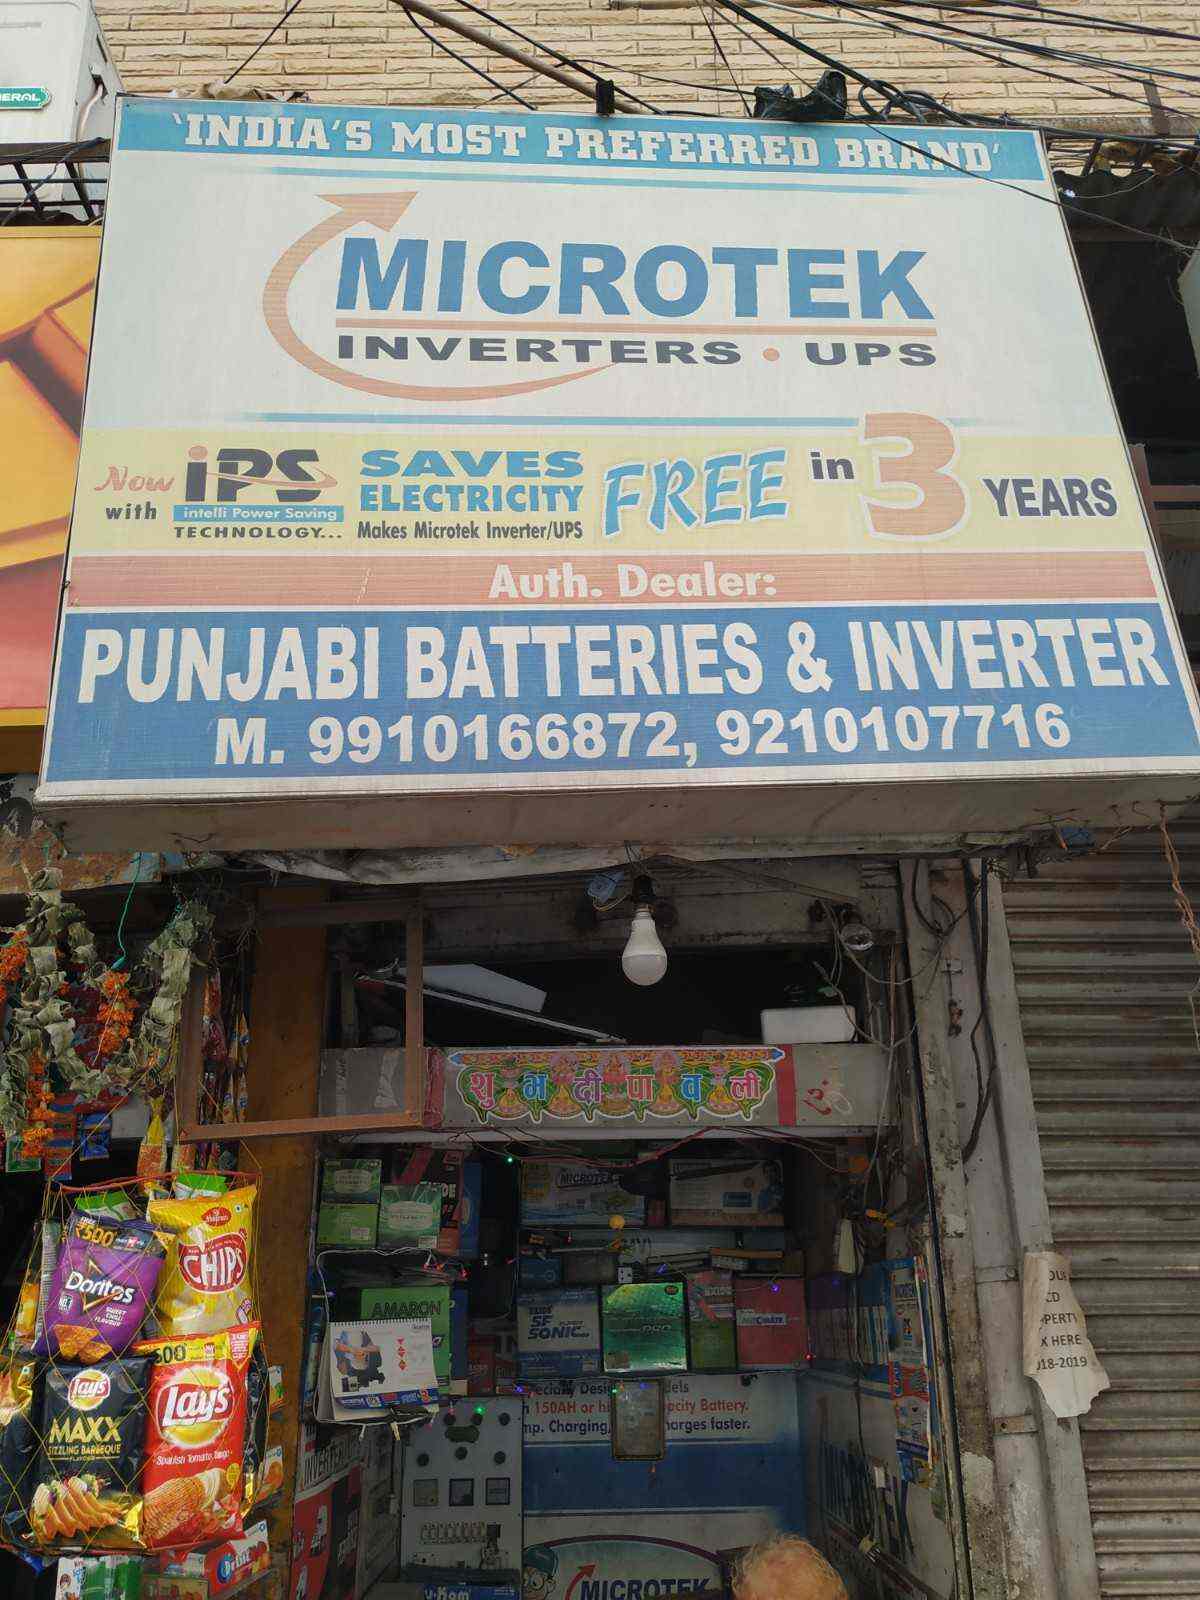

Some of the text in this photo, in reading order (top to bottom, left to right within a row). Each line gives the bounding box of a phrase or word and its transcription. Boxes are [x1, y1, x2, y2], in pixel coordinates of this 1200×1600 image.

[391, 120, 526, 158] MOST
[545, 126, 820, 168] PREFERRED
[336, 236, 935, 321] MICROTEK
[337, 334, 937, 367] INVERTERS UPS
[359, 449, 584, 478] SAVES
[603, 411, 1118, 538] FREE in 3 YEARS
[94, 465, 175, 492] Now
[105, 501, 157, 520] with
[359, 484, 584, 513] ELECTRICITY
[232, 508, 280, 519] Power
[285, 507, 338, 522] Saving
[357, 520, 584, 541] Makes Microtek Inverter/UPS
[489, 561, 777, 599] Auth. Dealer:
[77, 617, 1171, 704] PUNJABI BATTERIES & INVERTER
[214, 702, 1071, 769] M. 9910166872, 9210107716
[183, 1246, 244, 1287] CHIPS
[65, 1270, 135, 1304] Doritos
[1051, 1334, 1082, 1346] HERE
[535, 1400, 576, 1414] 150AH
[49, 1415, 122, 1443] MAXX
[156, 1454, 186, 1466] Spanish
